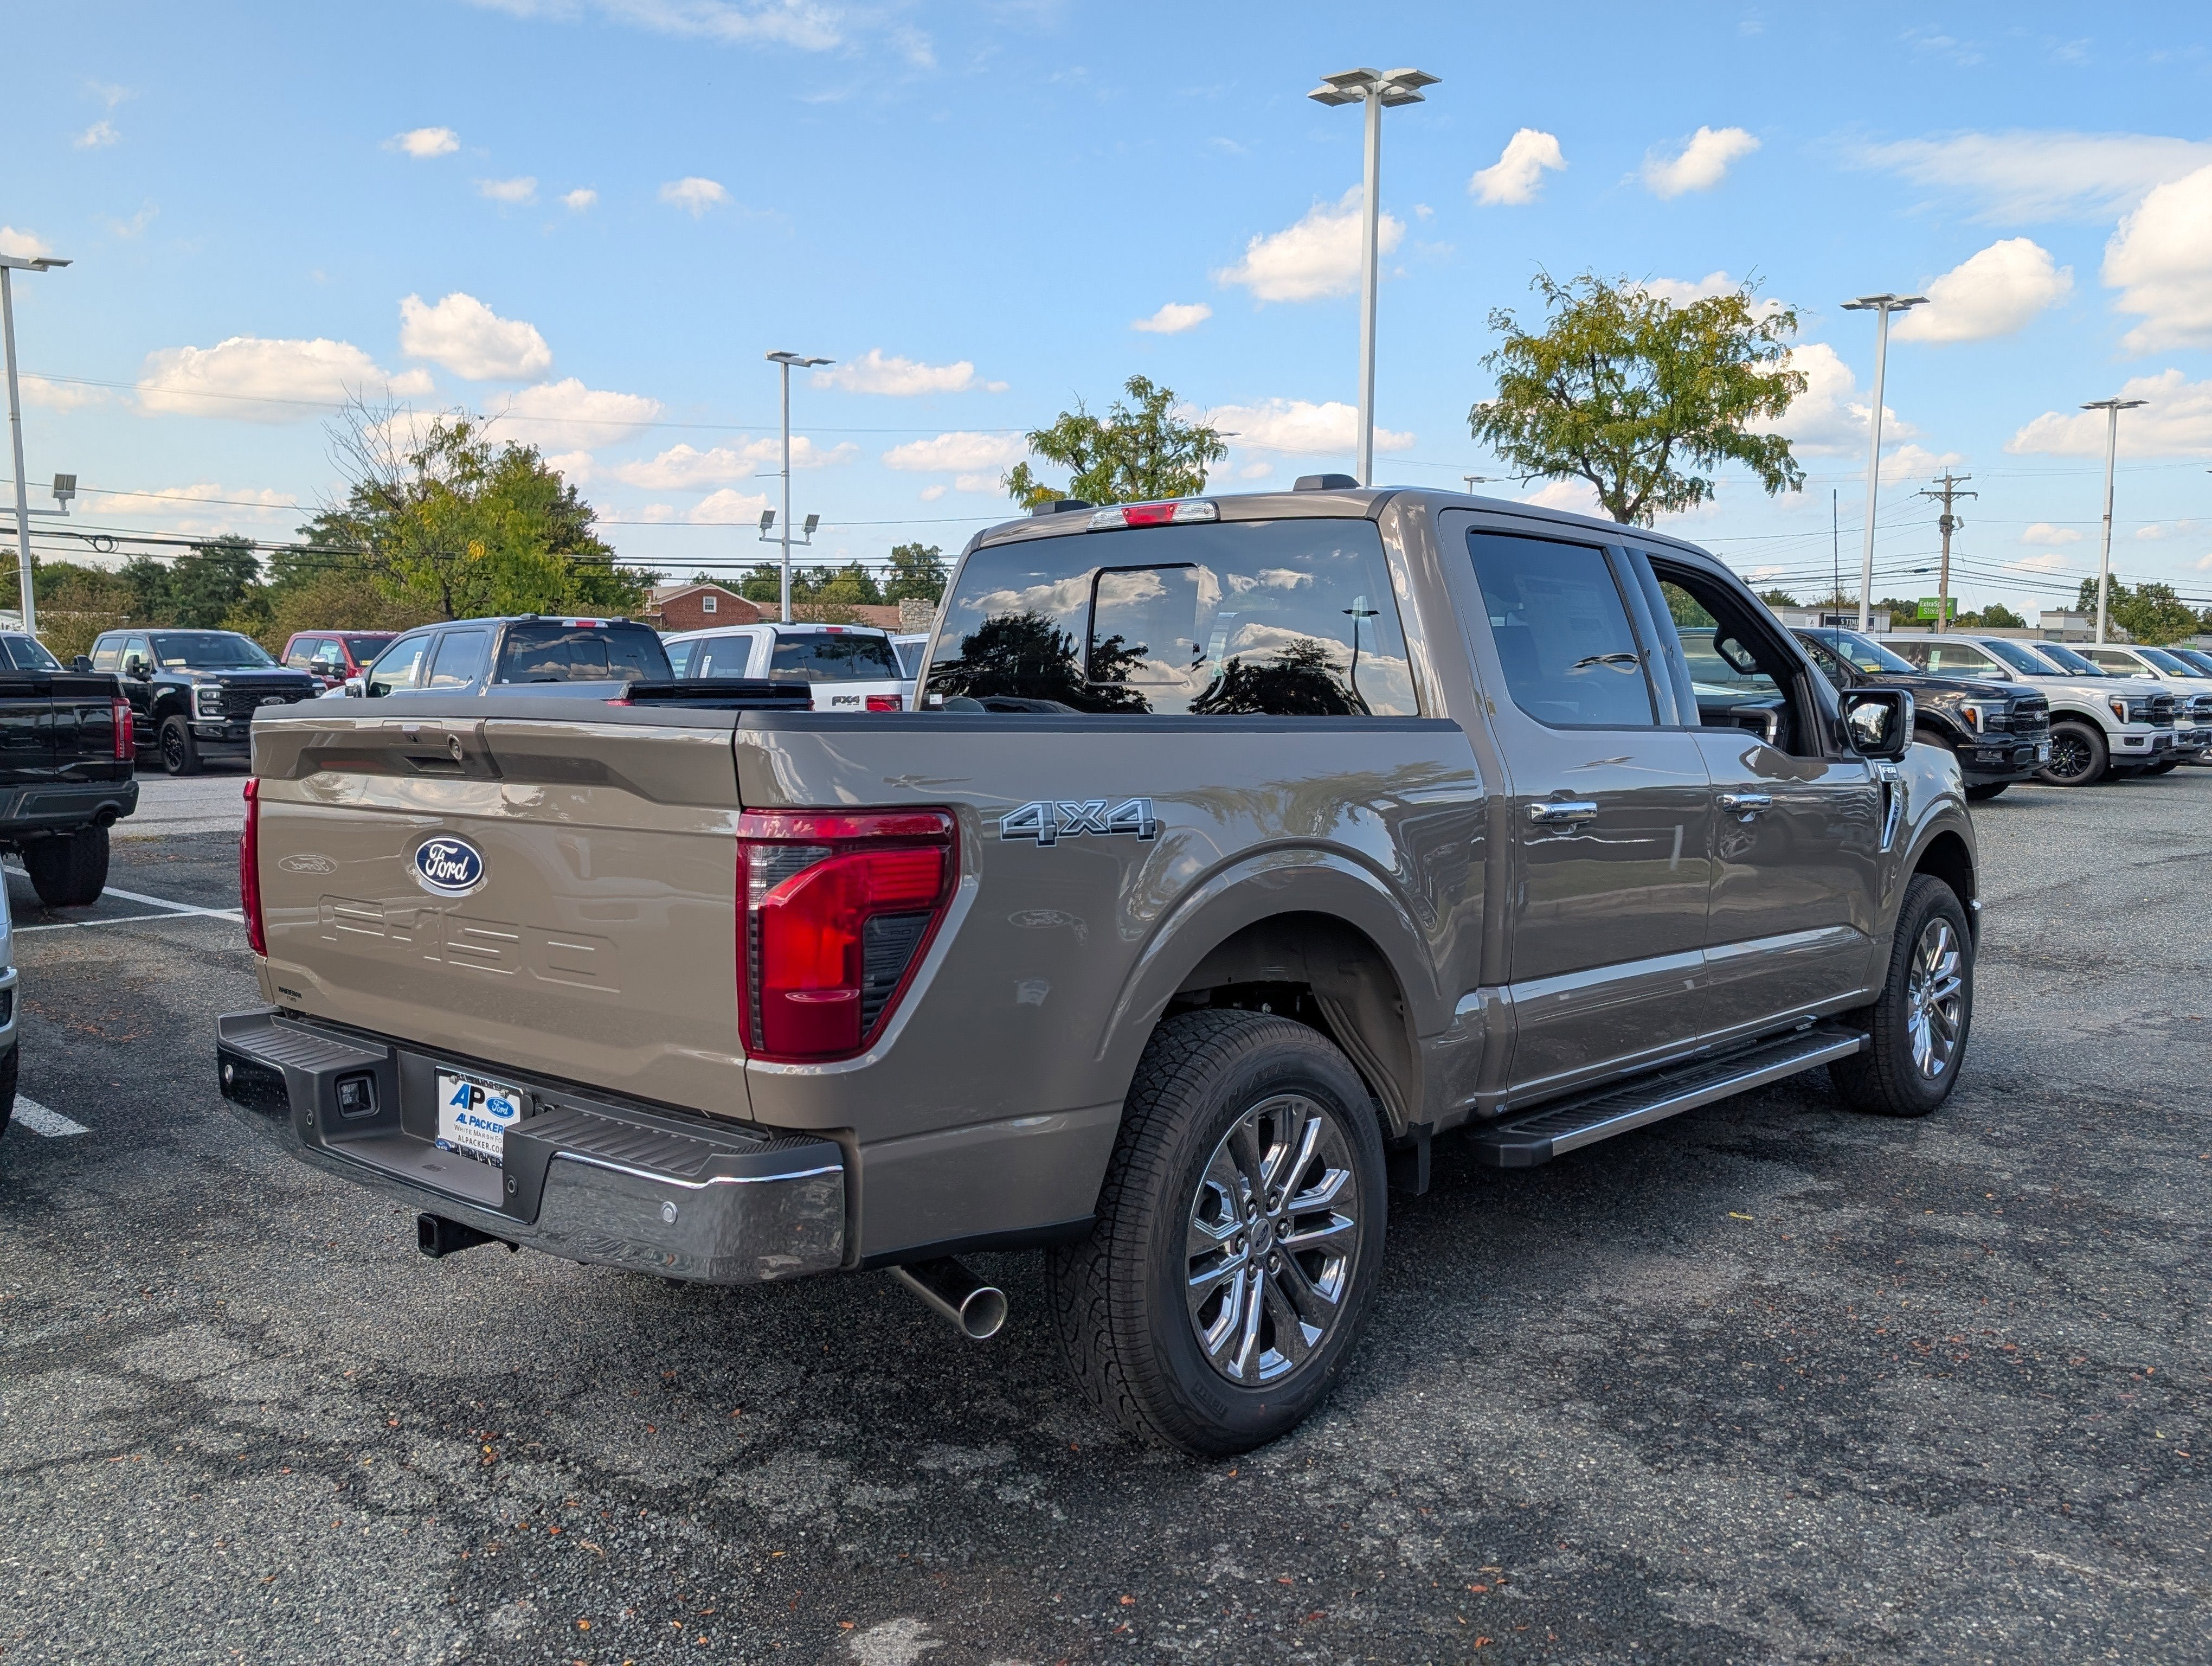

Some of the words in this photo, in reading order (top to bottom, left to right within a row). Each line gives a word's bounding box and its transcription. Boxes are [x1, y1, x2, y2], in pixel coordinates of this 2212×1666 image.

[1920, 600, 1951, 609] ExtraSpe
[832, 695, 860, 706] FX4
[426, 844, 470, 881] Ford
[449, 1083, 485, 1111] AP
[492, 1099, 509, 1115] Ford
[455, 1112, 467, 1125] AL
[454, 1124, 472, 1135] WHITE
[473, 1130, 494, 1142] MARSH
[495, 1135, 503, 1144] FO
